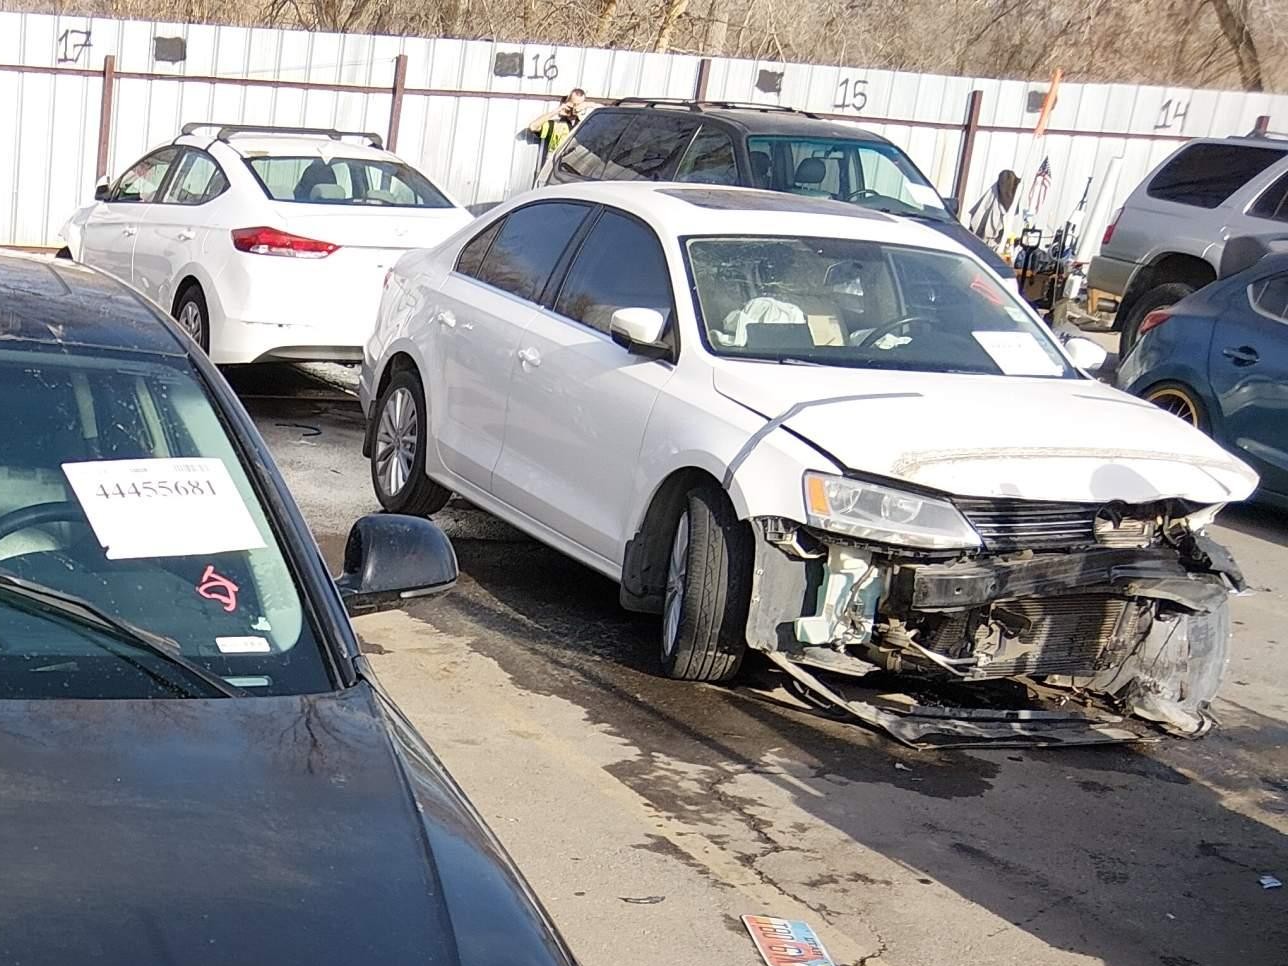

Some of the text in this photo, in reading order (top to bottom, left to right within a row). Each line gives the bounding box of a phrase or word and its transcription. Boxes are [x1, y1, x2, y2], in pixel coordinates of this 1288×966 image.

[58, 29, 93, 63] 17
[527, 53, 559, 80] 16
[833, 77, 869, 112] 15
[1153, 99, 1191, 133] 14
[95, 479, 217, 499] 44455681
[803, 937, 824, 957] UTAH
